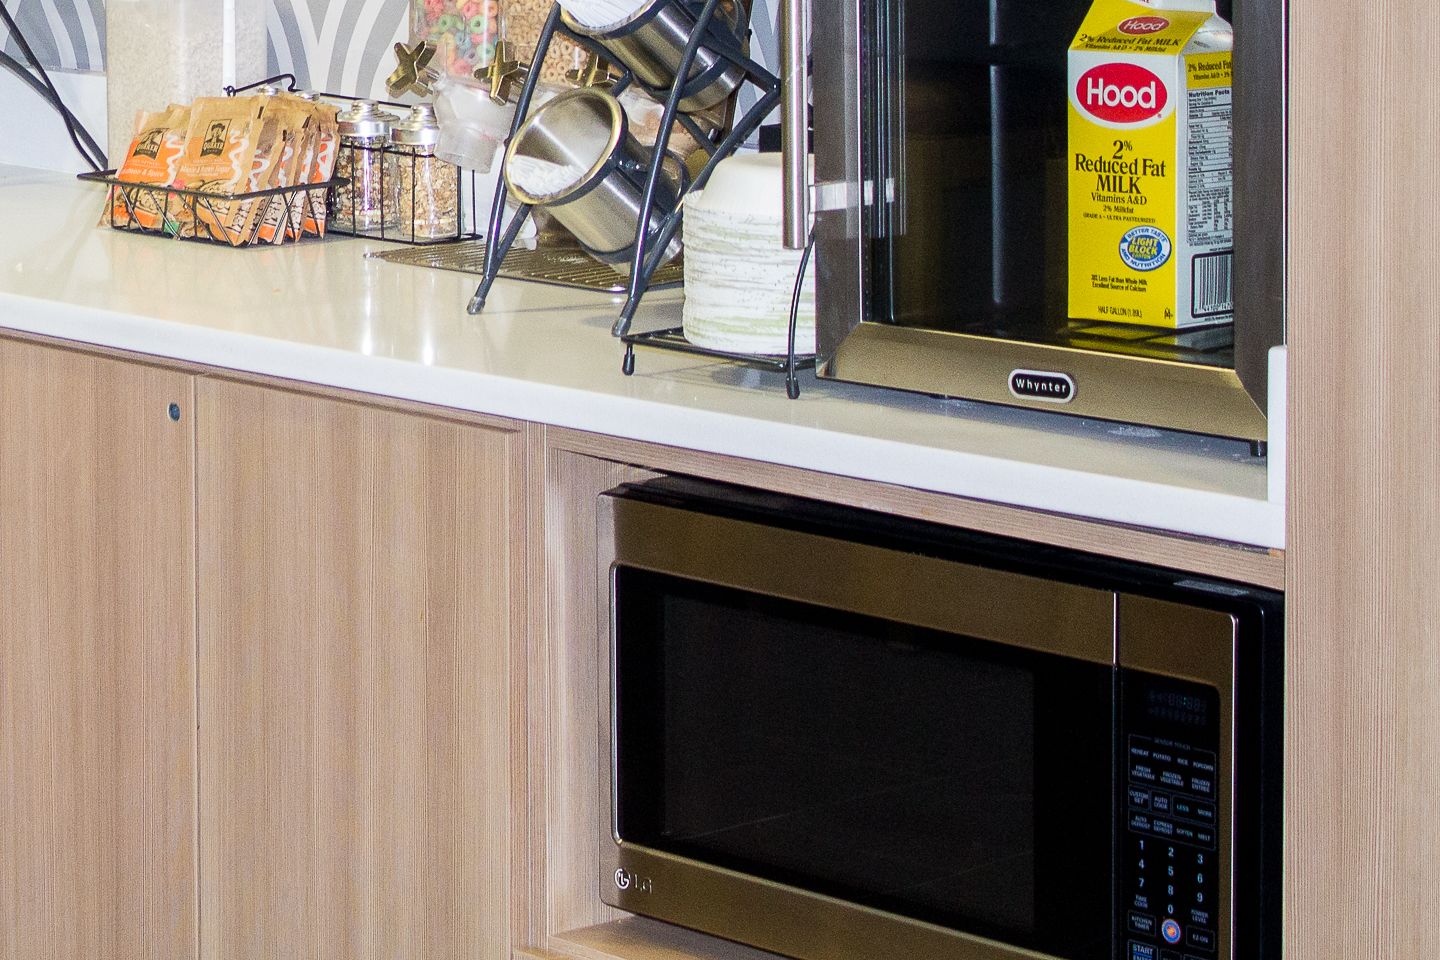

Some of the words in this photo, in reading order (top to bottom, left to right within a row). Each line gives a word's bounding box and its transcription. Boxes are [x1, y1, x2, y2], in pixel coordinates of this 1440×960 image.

[1124, 20, 1165, 30] Hood
[1079, 34, 1095, 43] 2%
[1096, 36, 1136, 45] Reduced
[1137, 37, 1152, 45] Fat
[1198, 61, 1221, 71] Reduced
[1087, 77, 1156, 109] Hood
[1113, 140, 1133, 160] 2%
[1075, 153, 1138, 175] Reduced
[1142, 159, 1166, 177] Fat
[1096, 174, 1141, 194] MILK
[1091, 192, 1125, 204] Vitamins
[1127, 194, 1147, 205] A&D
[1114, 206, 1134, 214] Milkfat
[1127, 228, 1149, 238] BETTER
[1151, 229, 1168, 242] TASTE
[1132, 236, 1158, 246] LIGHT
[1129, 245, 1158, 255] BLOCK
[1131, 253, 1166, 267] NUTRITION
[1092, 281, 1109, 289] Excellent
[1110, 306, 1127, 316] GALLON
[1016, 378, 1066, 393] Whynter
[1176, 804, 1190, 812] LESS
[1139, 840, 1144, 850] 1
[1168, 847, 1174, 857] 2
[1138, 858, 1144, 869] 4
[1197, 853, 1203, 865] 3
[1168, 866, 1174, 876] 5
[1139, 877, 1144, 888] 7
[1197, 873, 1203, 883] 6
[1168, 885, 1174, 896] 8
[1197, 892, 1203, 903] 9
[1168, 904, 1174, 914] 0
[1133, 944, 1153, 955] START
